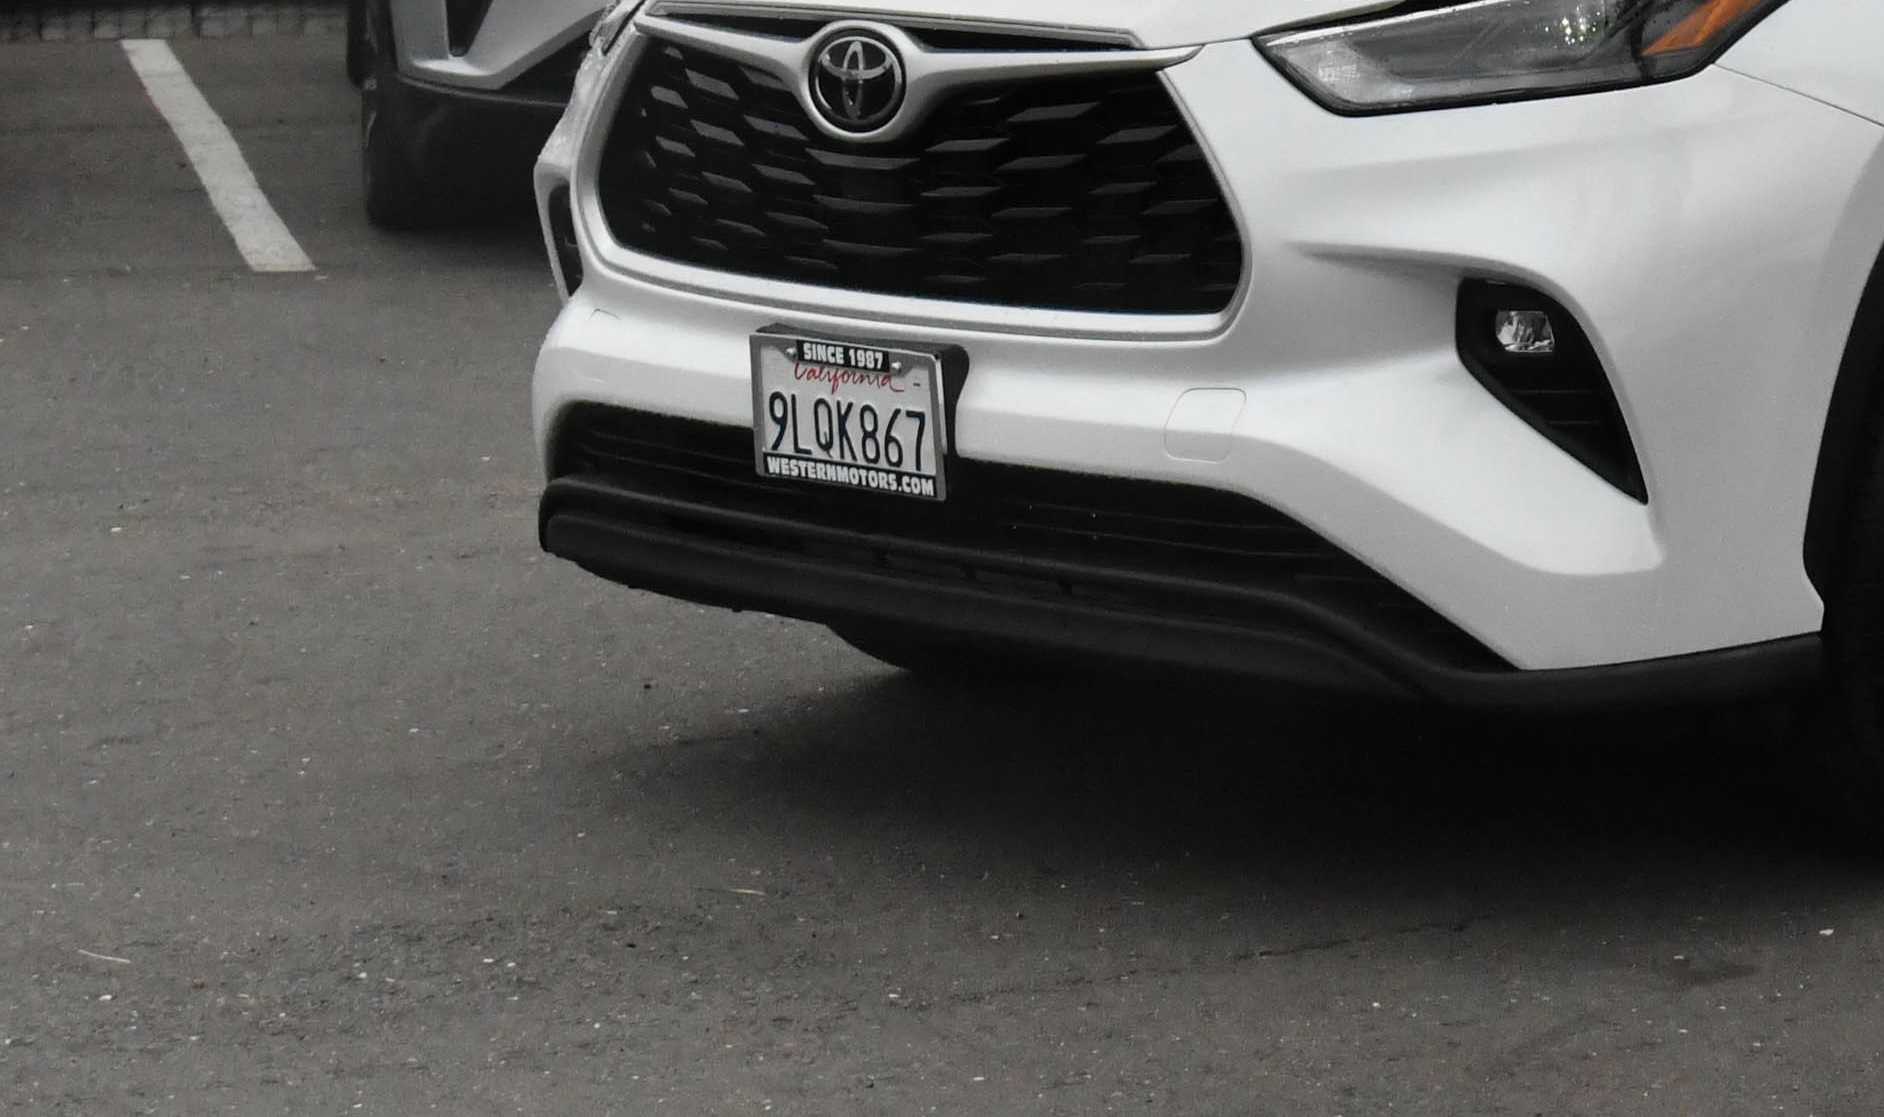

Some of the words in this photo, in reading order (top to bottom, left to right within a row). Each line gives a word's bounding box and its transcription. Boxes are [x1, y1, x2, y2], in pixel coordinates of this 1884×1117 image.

[803, 342, 844, 365] SINCE
[849, 349, 883, 370] 1987
[769, 391, 926, 471] 9LQK867
[766, 456, 935, 495] WESTERNMOTORS.COM
